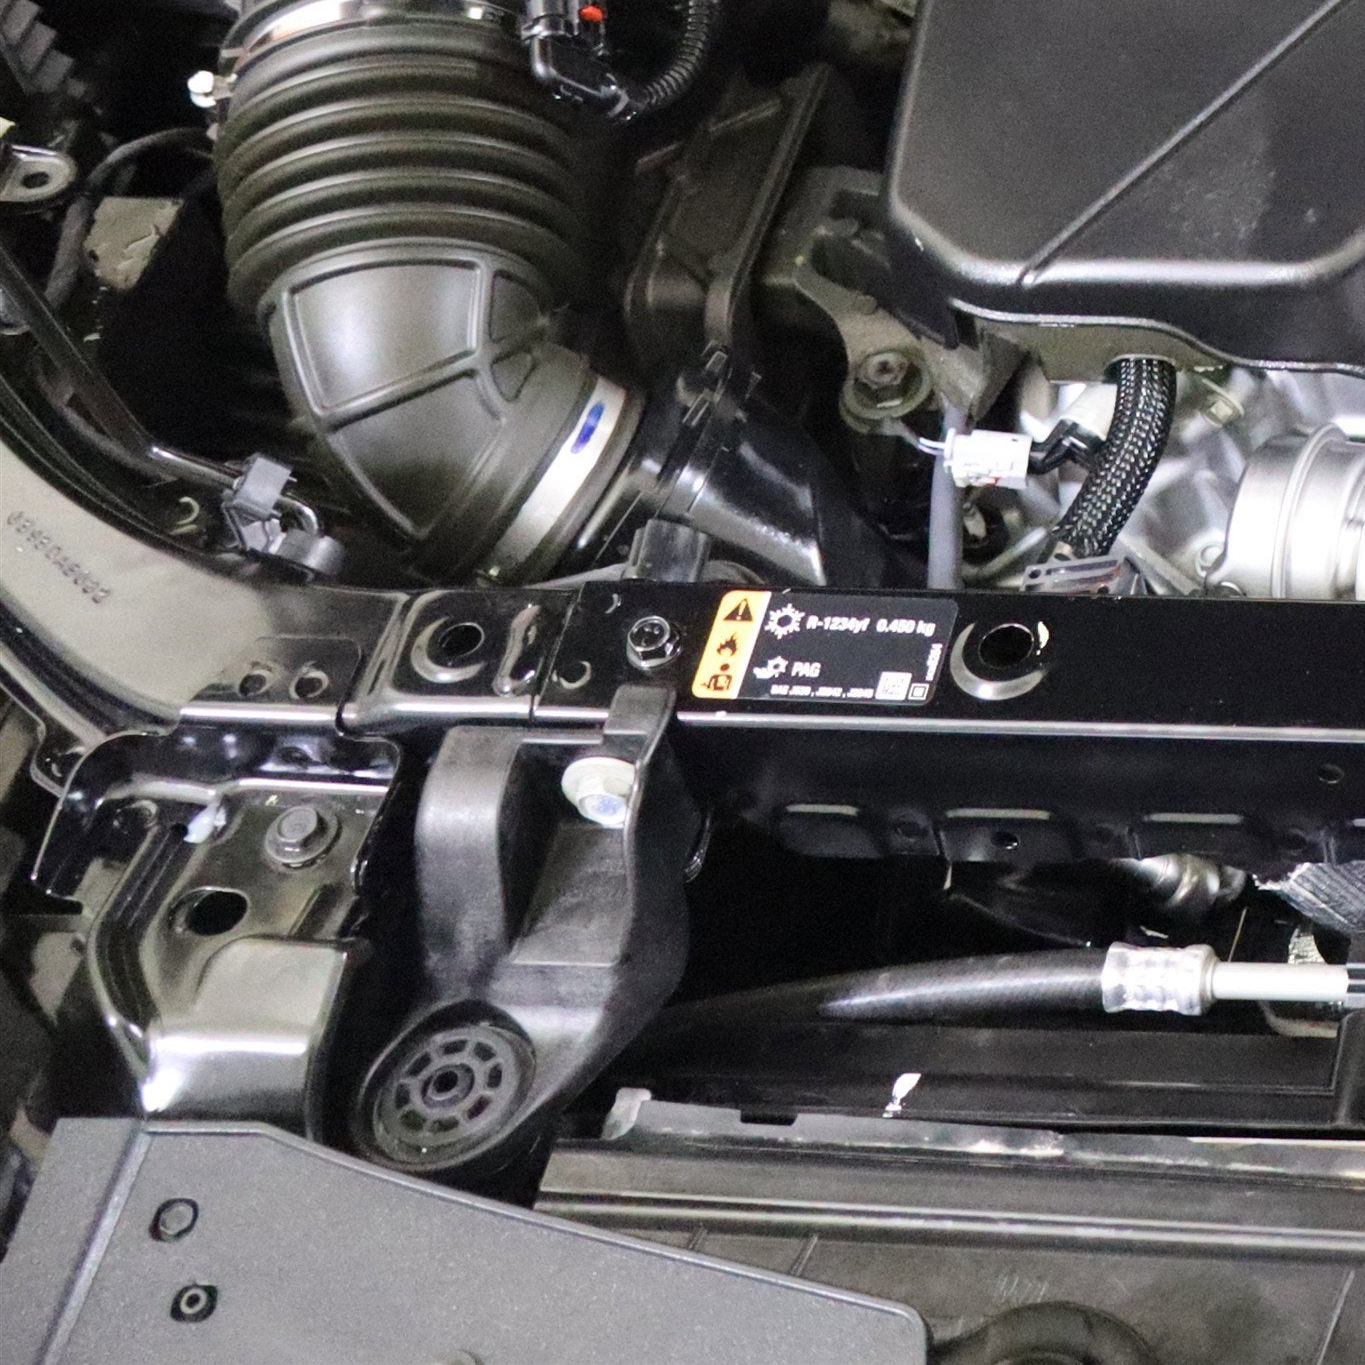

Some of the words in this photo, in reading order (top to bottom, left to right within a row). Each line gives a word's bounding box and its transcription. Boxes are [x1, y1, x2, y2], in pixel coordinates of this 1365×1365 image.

[806, 615, 870, 634] R-1234yf
[917, 620, 936, 638] kg
[791, 661, 821, 678] PAG
